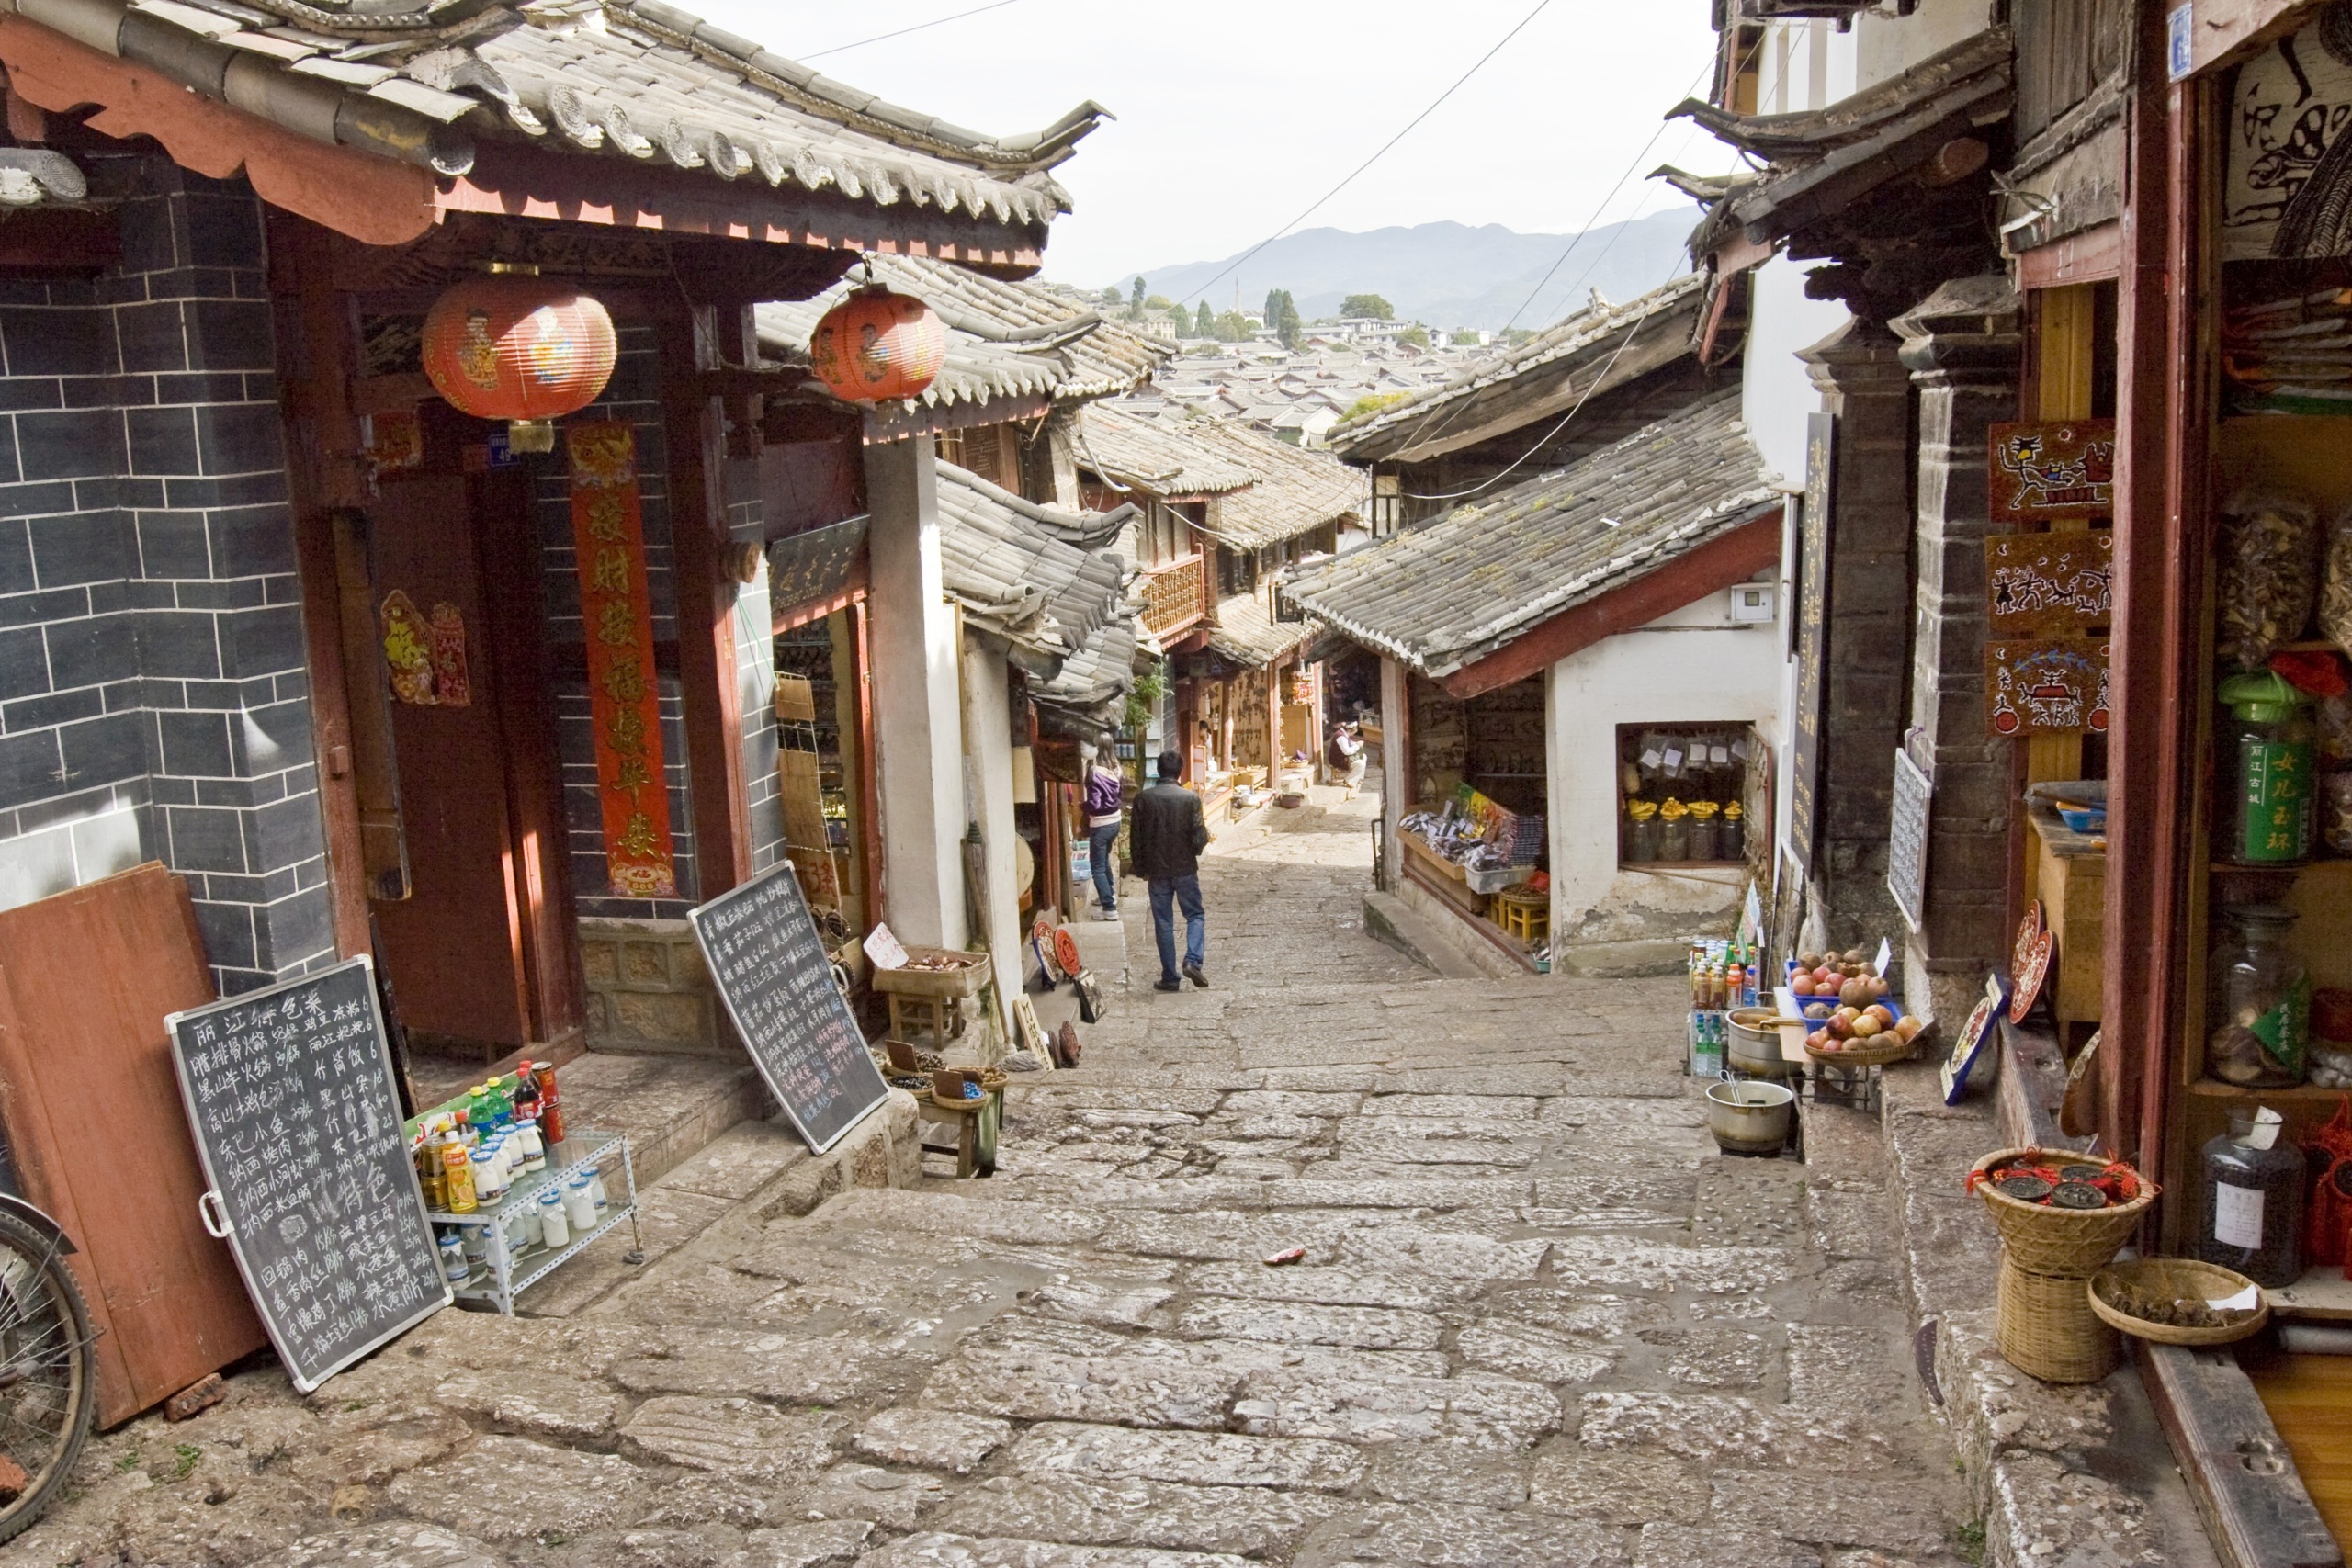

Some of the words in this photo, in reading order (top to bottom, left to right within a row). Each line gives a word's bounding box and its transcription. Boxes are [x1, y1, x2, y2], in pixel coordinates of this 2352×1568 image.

[194, 992, 324, 1047] 丽江特色菜
[363, 996, 368, 1011] 6
[367, 1017, 372, 1031] 6
[190, 1032, 268, 1077] 腊排骨火锅
[314, 1043, 365, 1080] 竹筒饭
[371, 1041, 377, 1059] 6
[198, 1055, 271, 1102] 黑山羊火锅
[373, 1068, 382, 1087] 18
[219, 1111, 290, 1162] 东巴小鱼
[226, 1137, 294, 1190] 纳西烤肉
[232, 1158, 308, 1216] 纳西小河虾
[339, 1203, 394, 1242] 麻婆豆腐
[346, 1229, 396, 1261] 酸菜鱼
[356, 1244, 401, 1280] 水煮鱼
[261, 1247, 308, 1288] 回锅肉
[267, 1262, 330, 1314] 鱼香肉丝
[362, 1258, 410, 1302] 辣子鸡
[371, 1275, 424, 1321] 水煮肉片
